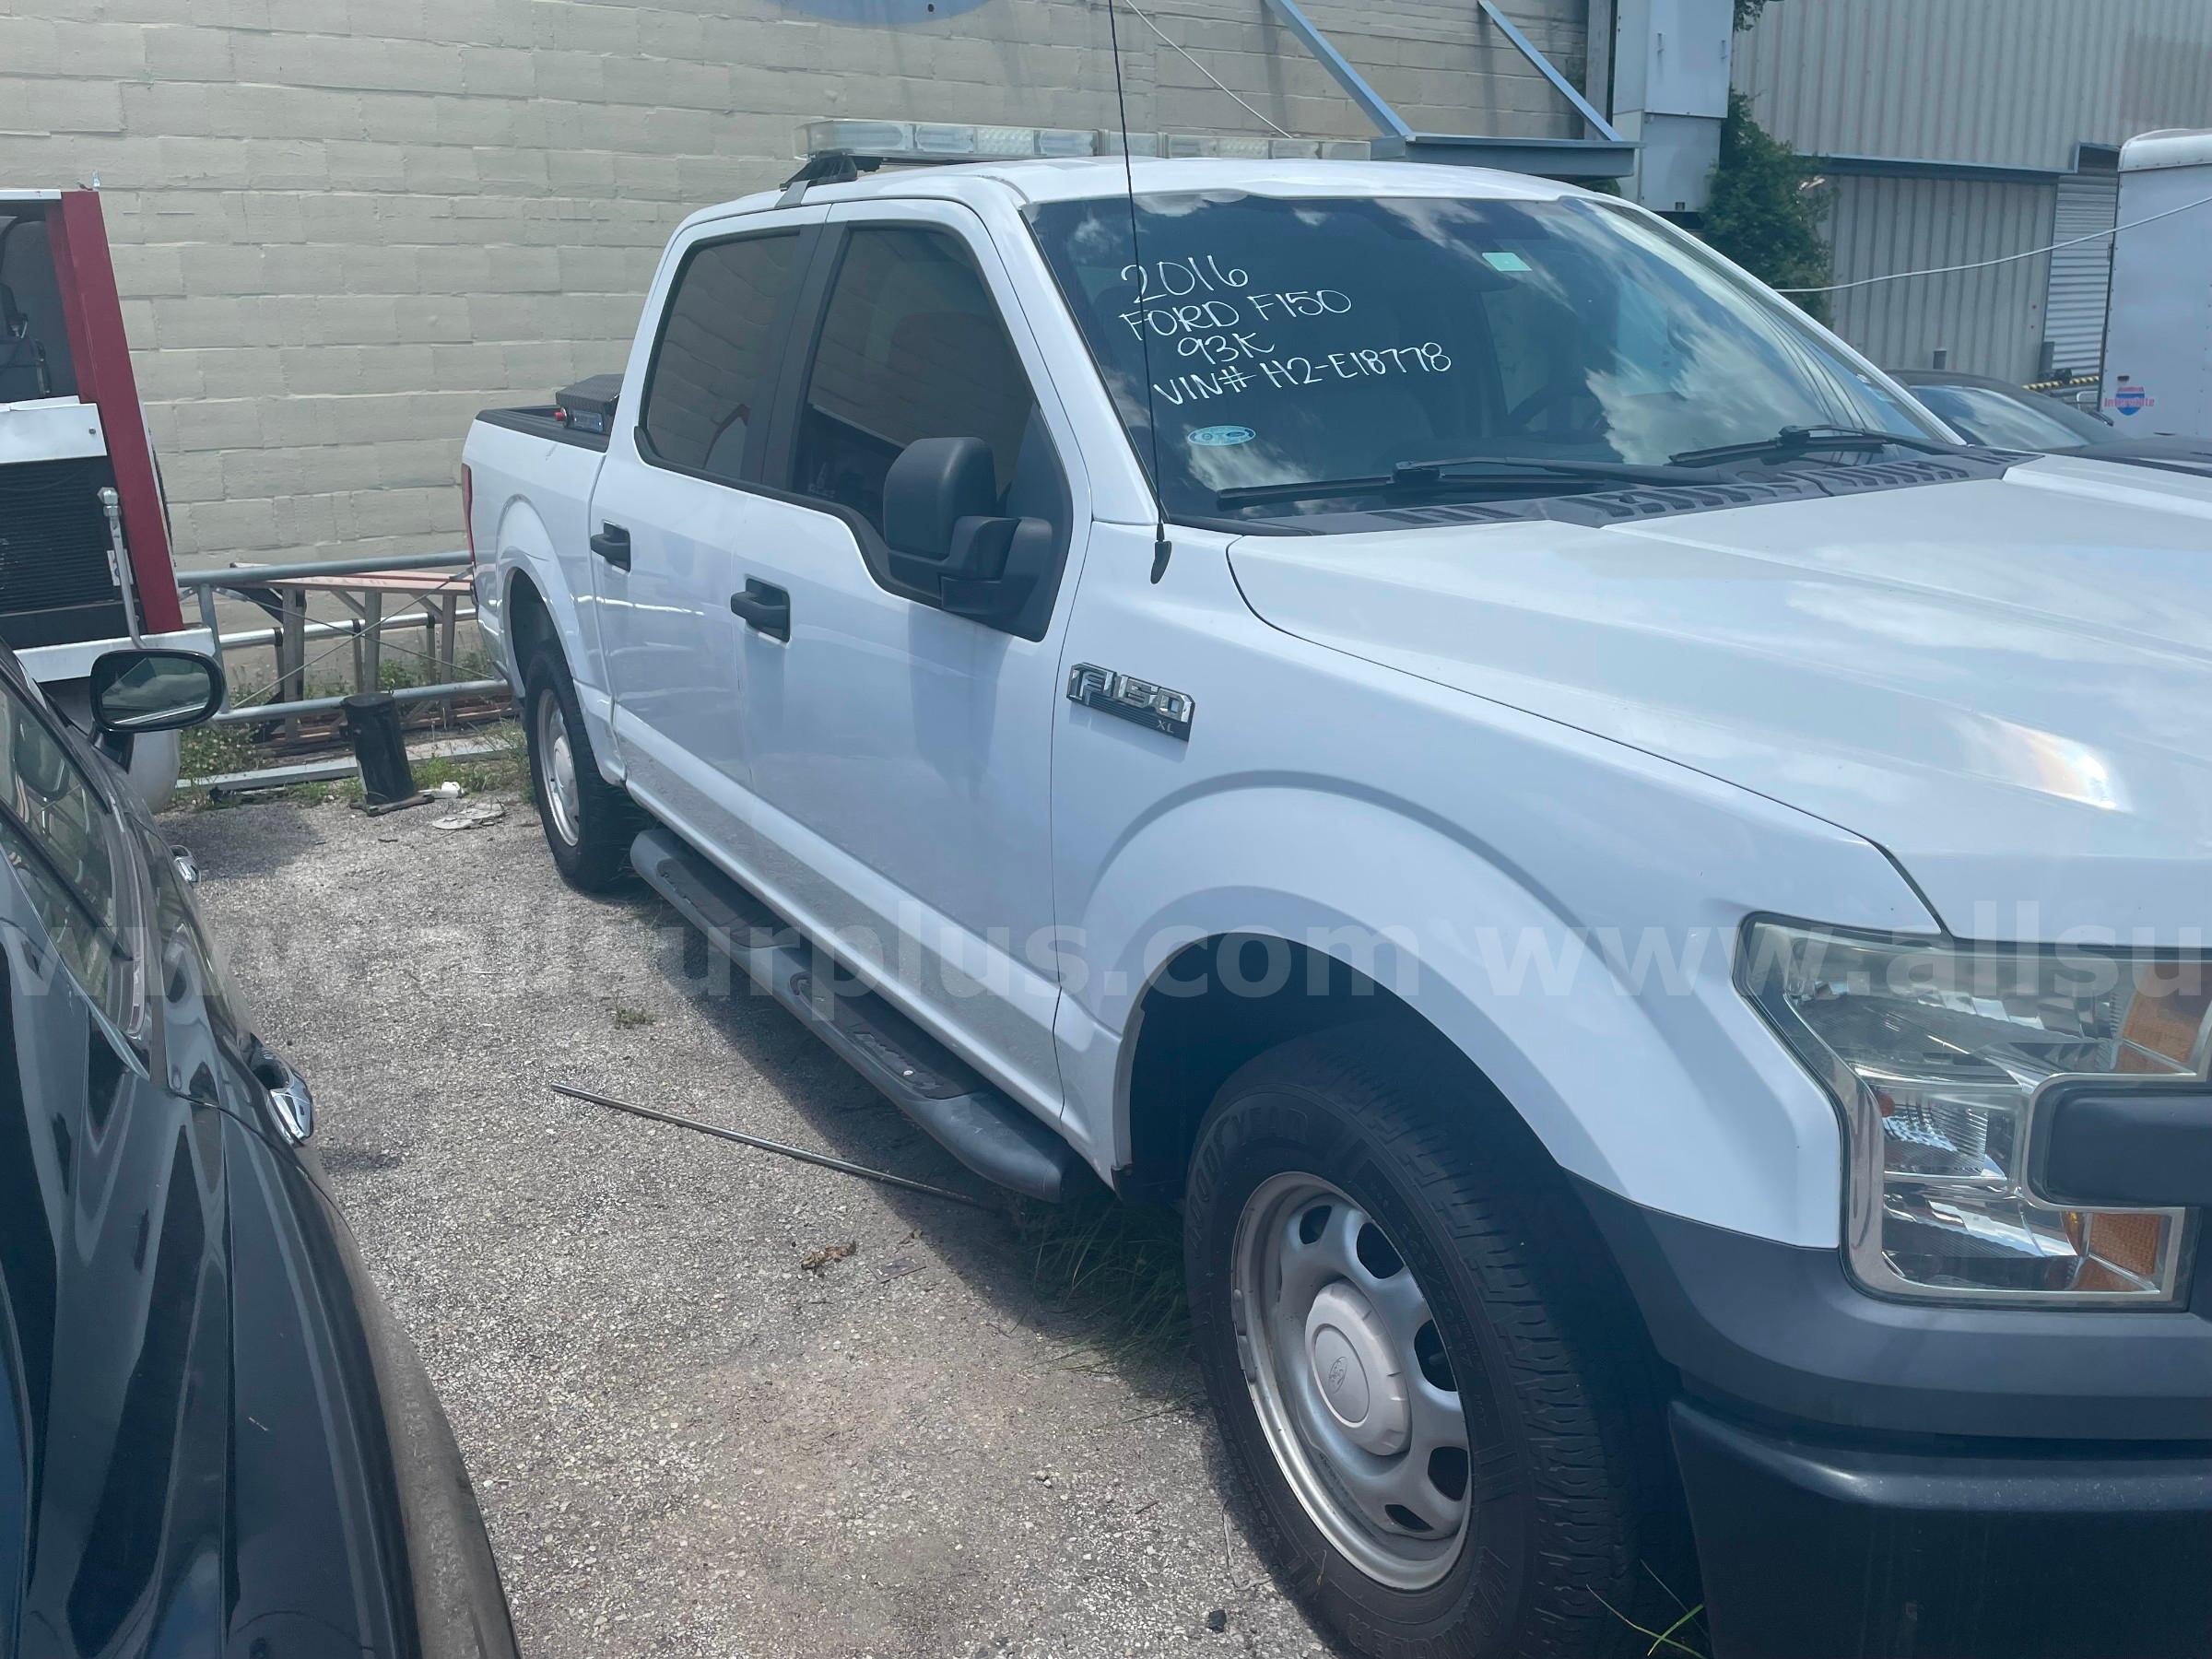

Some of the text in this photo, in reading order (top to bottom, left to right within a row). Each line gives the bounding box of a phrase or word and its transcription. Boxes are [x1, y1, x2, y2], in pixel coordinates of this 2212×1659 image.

[1121, 254, 1248, 304] 2016
[1118, 289, 1352, 341] FORD F150
[1177, 332, 1275, 365] 93K
[1154, 342, 1452, 406] VIN# H2-E18778
[1157, 719, 1174, 734] XL
